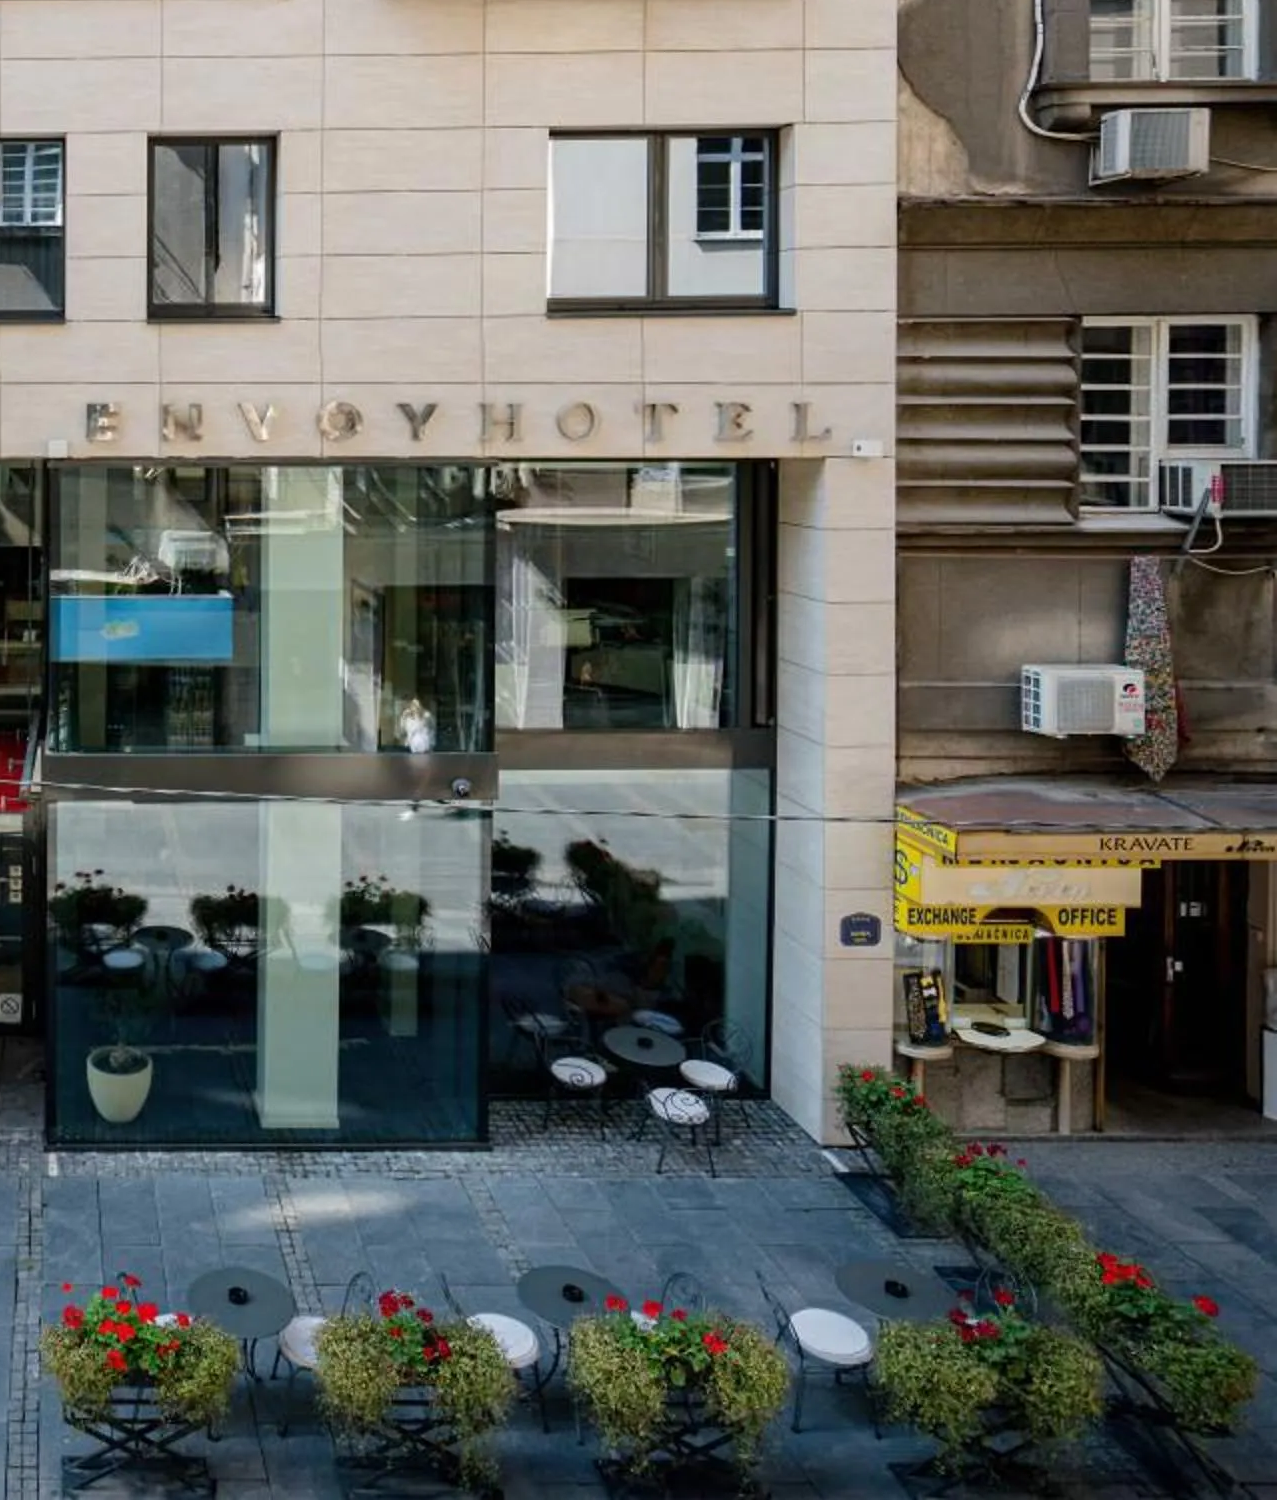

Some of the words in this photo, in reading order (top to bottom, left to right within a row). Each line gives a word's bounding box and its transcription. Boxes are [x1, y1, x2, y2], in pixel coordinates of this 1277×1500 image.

[86, 401, 438, 443] ENVOY
[477, 402, 833, 443] HOTEL
[1099, 837, 1194, 852] KRAVATE
[908, 907, 978, 926] EXCHANGE
[1058, 908, 1117, 926] OFFICE
